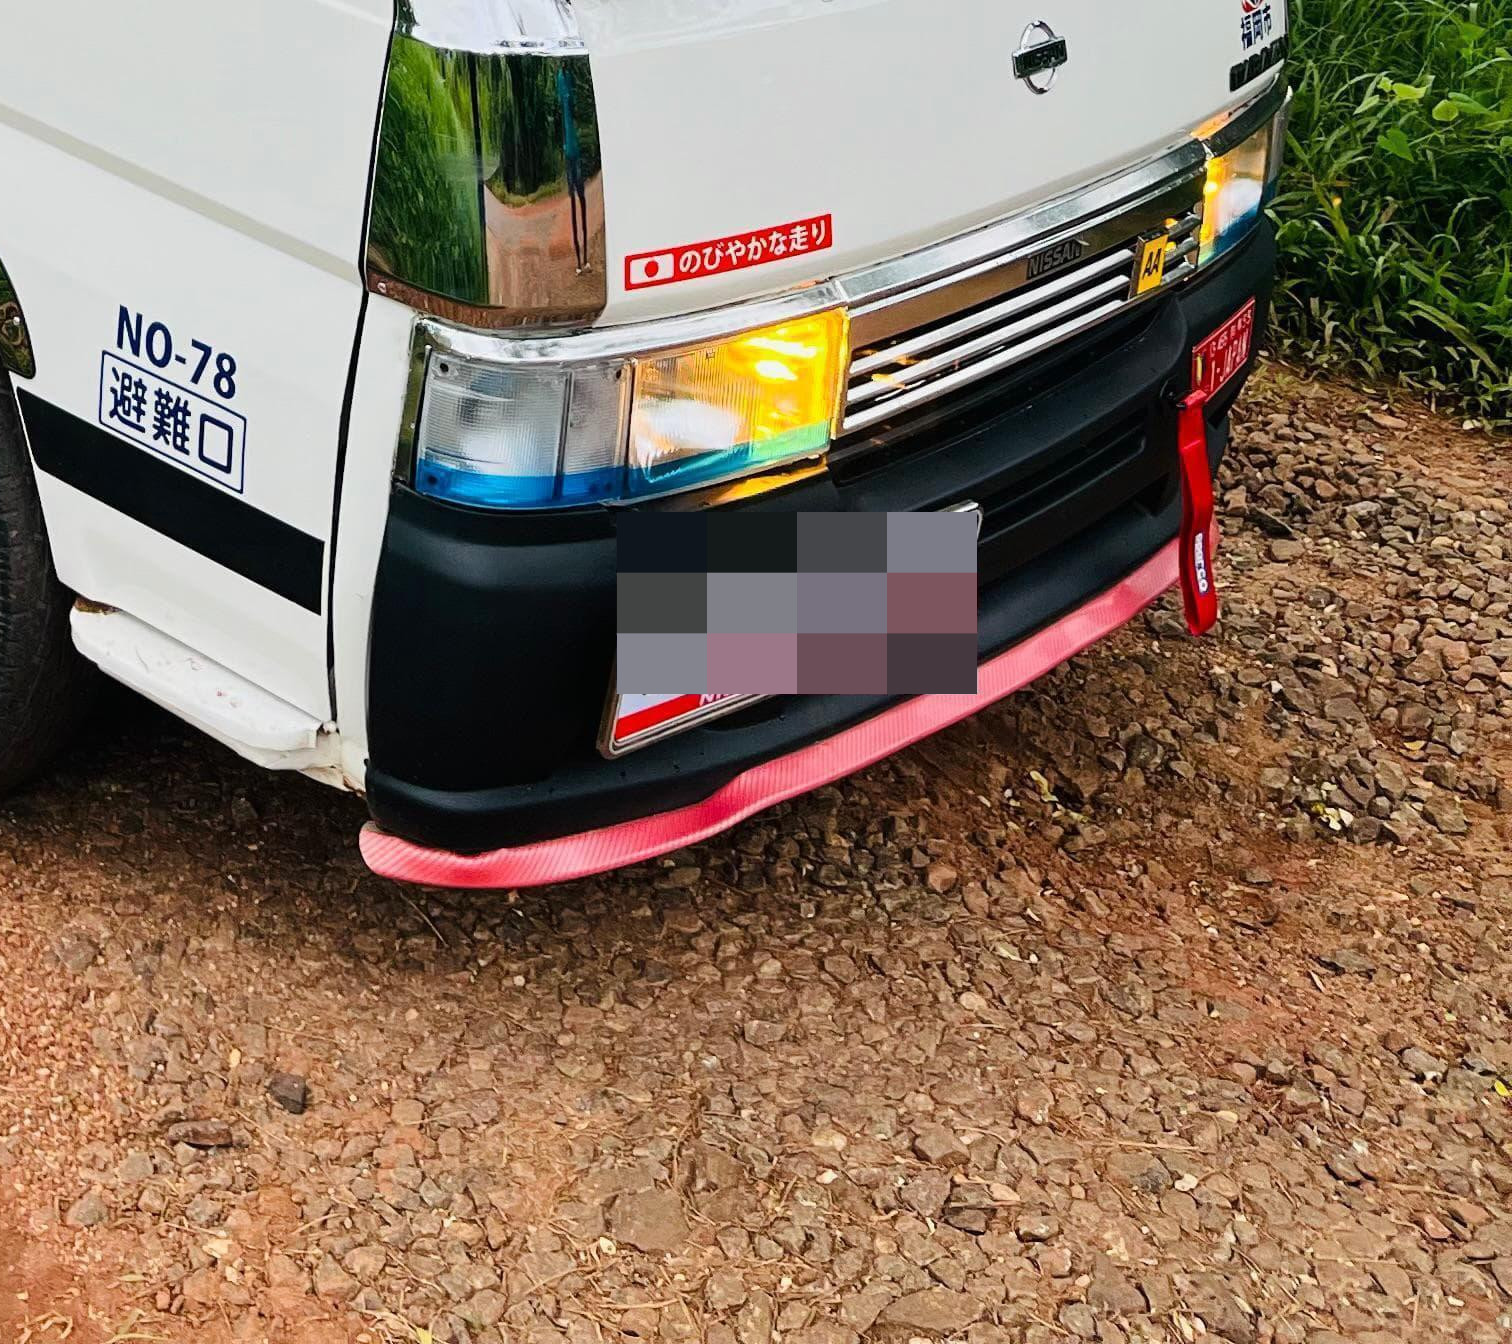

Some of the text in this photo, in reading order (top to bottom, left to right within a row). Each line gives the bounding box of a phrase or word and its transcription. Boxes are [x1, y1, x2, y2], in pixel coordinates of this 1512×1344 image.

[678, 219, 827, 274] のびやかな走り
[1028, 238, 1082, 279] NISSAN
[1141, 247, 1163, 280] AA
[116, 303, 237, 400] NO-78
